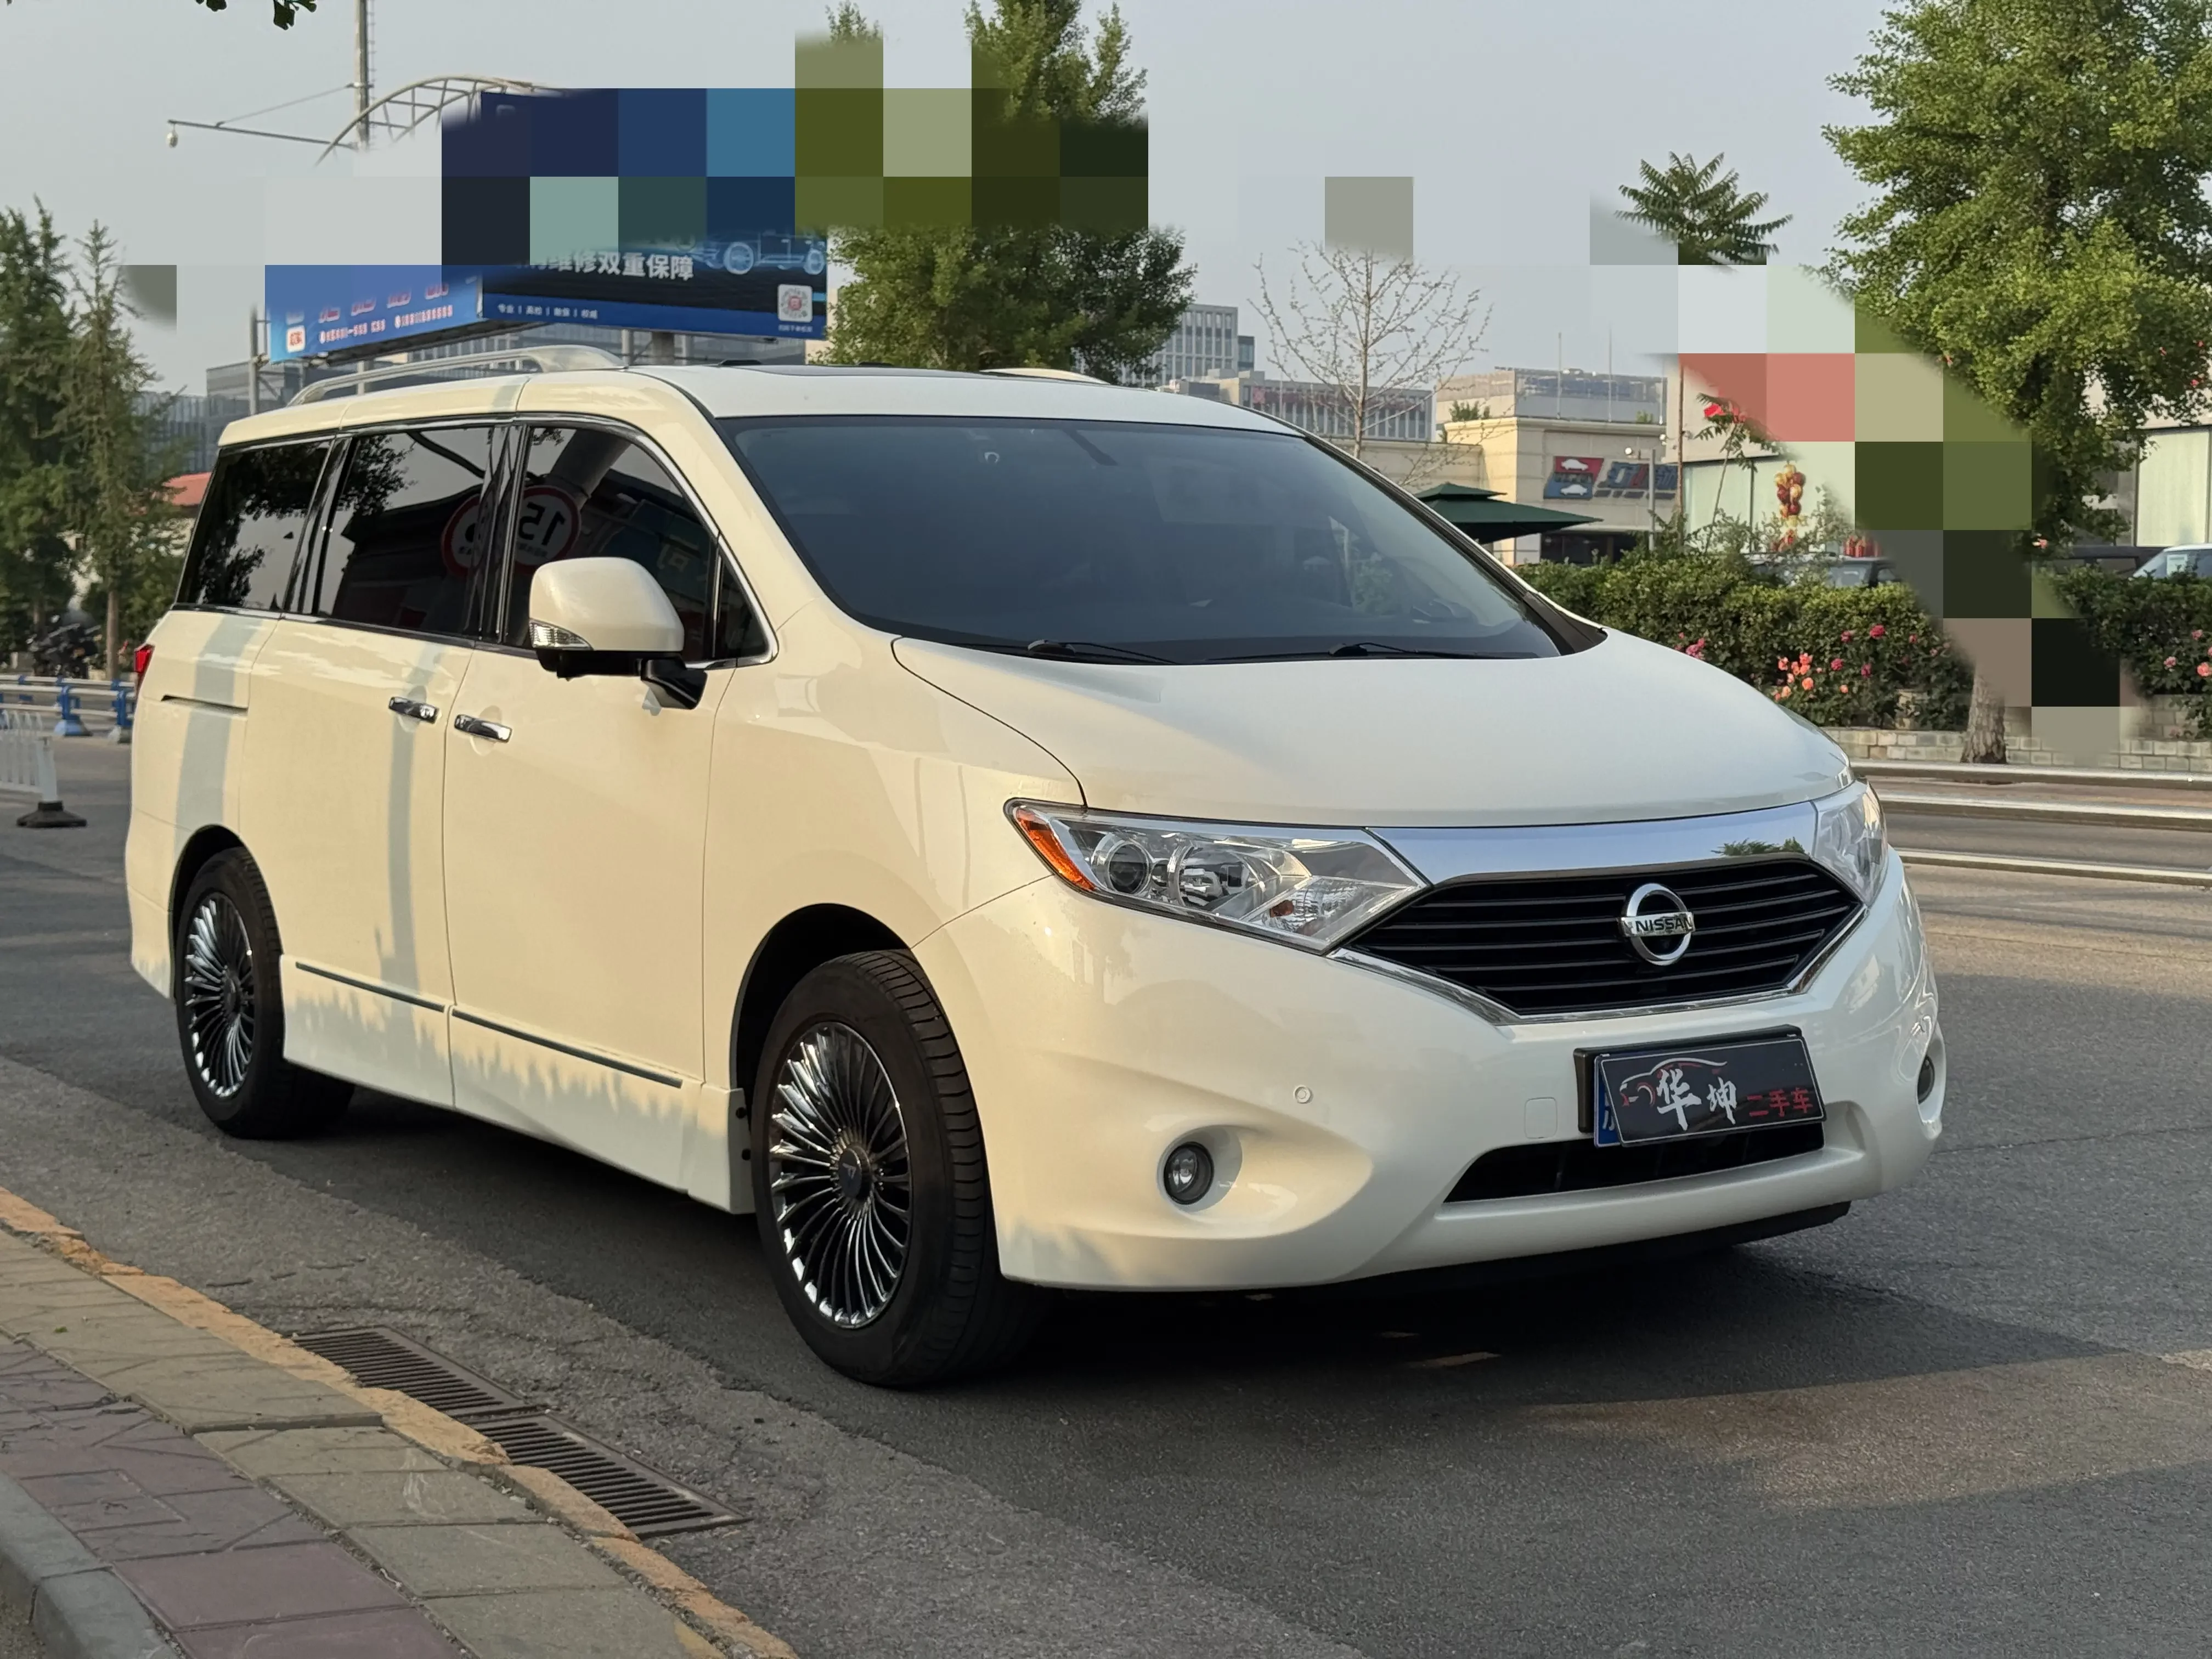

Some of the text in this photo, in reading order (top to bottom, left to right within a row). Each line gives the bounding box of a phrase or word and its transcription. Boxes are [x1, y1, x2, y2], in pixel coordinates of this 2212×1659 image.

[535, 250, 694, 281] 维修双重保障
[1635, 915, 1693, 932] NISSAN
[1656, 1068, 1737, 1131] 华坤
[1747, 1087, 1813, 1118] 二手车
